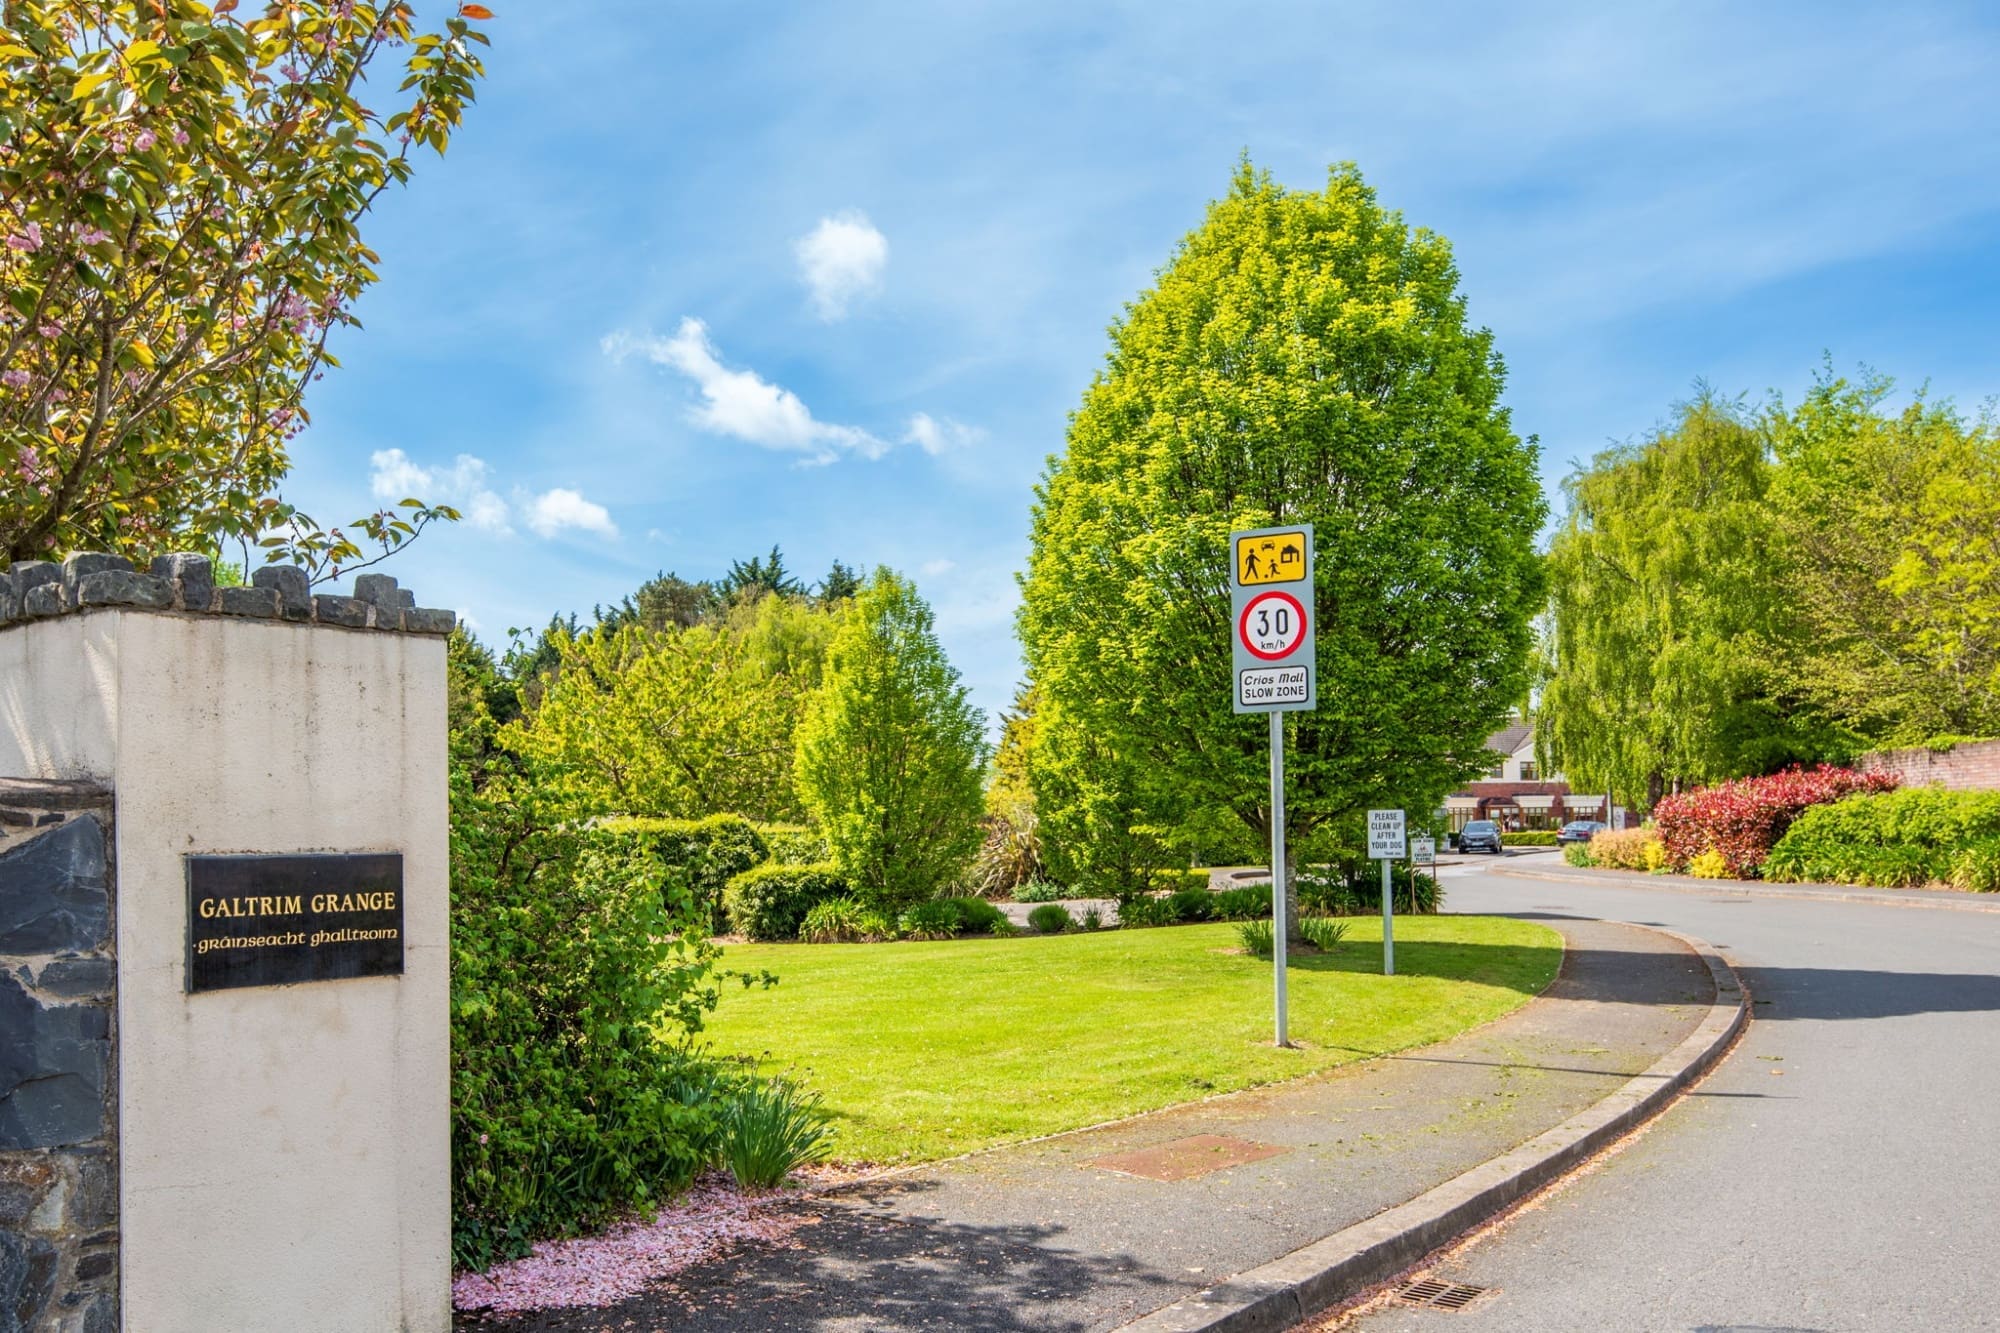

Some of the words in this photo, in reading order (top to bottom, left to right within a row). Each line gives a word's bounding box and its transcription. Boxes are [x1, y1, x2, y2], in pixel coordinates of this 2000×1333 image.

[1257, 609, 1288, 636] 30
[1261, 639, 1286, 650] km/h
[1244, 675, 1275, 686] Crios
[1278, 672, 1304, 684] Mall
[1244, 687, 1274, 699] SLOW
[1276, 685, 1305, 697] ZONE
[1374, 813, 1397, 821] PLEASE
[1371, 822, 1391, 830] CLEAN
[1371, 841, 1388, 849] YOUR
[1390, 841, 1402, 849] DOG
[200, 895, 303, 919] GALTRIM
[311, 892, 396, 914] GRANGE
